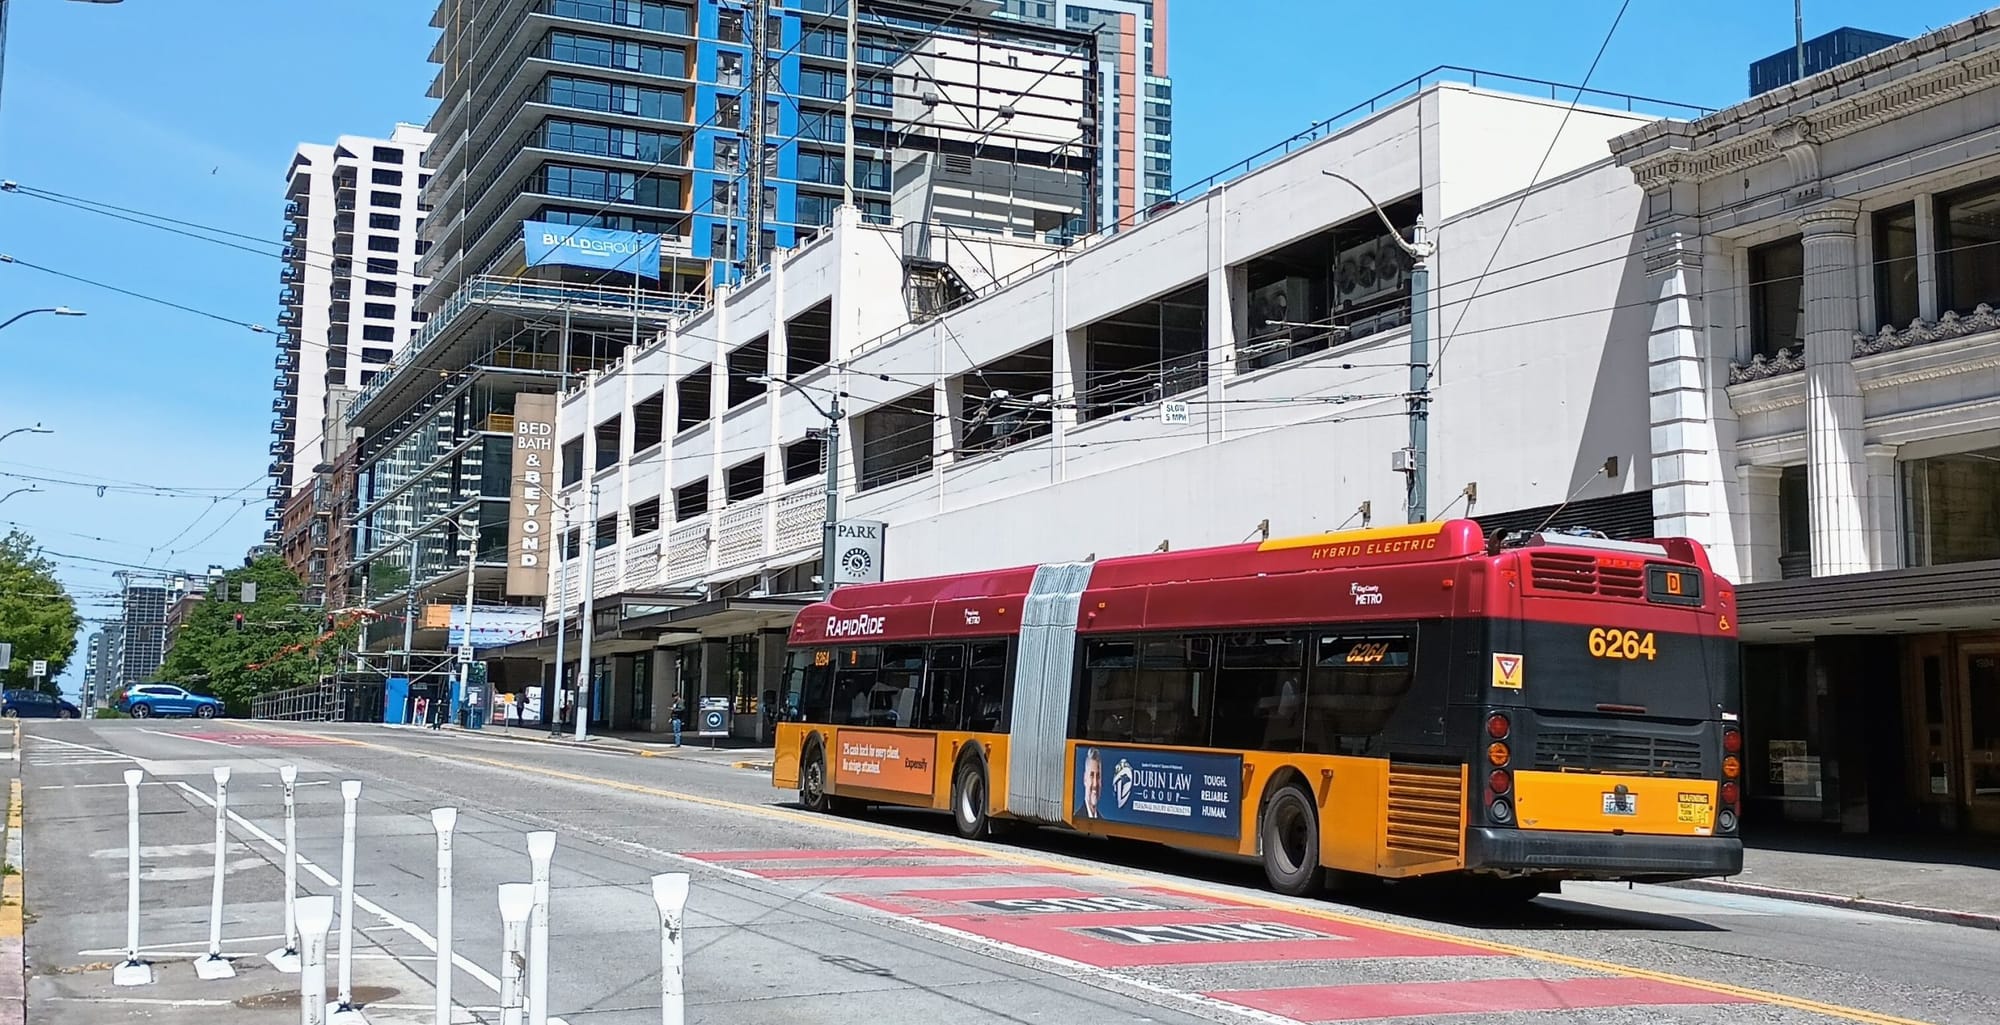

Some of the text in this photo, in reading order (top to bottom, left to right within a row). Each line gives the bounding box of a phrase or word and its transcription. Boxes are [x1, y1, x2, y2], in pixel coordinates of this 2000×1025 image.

[518, 421, 552, 435] BED
[518, 436, 552, 450] BATH
[526, 453, 540, 467] &
[520, 470, 541, 567] BEYOND
[838, 525, 877, 539] PARK
[1311, 538, 1436, 559] HYBRID ELECTRIC
[1665, 572, 1681, 595] D
[1355, 593, 1383, 605] METRO
[1588, 627, 1657, 660] 6264
[1346, 643, 1389, 662] 6264
[904, 757, 928, 772] Expensify
[1133, 769, 1192, 791] DUBIN LAW
[1204, 774, 1227, 787] TOUGH.
[1142, 789, 1180, 802] GROUP
[1201, 790, 1229, 803] RELIABLE.
[1202, 805, 1227, 818] HUMAN.
